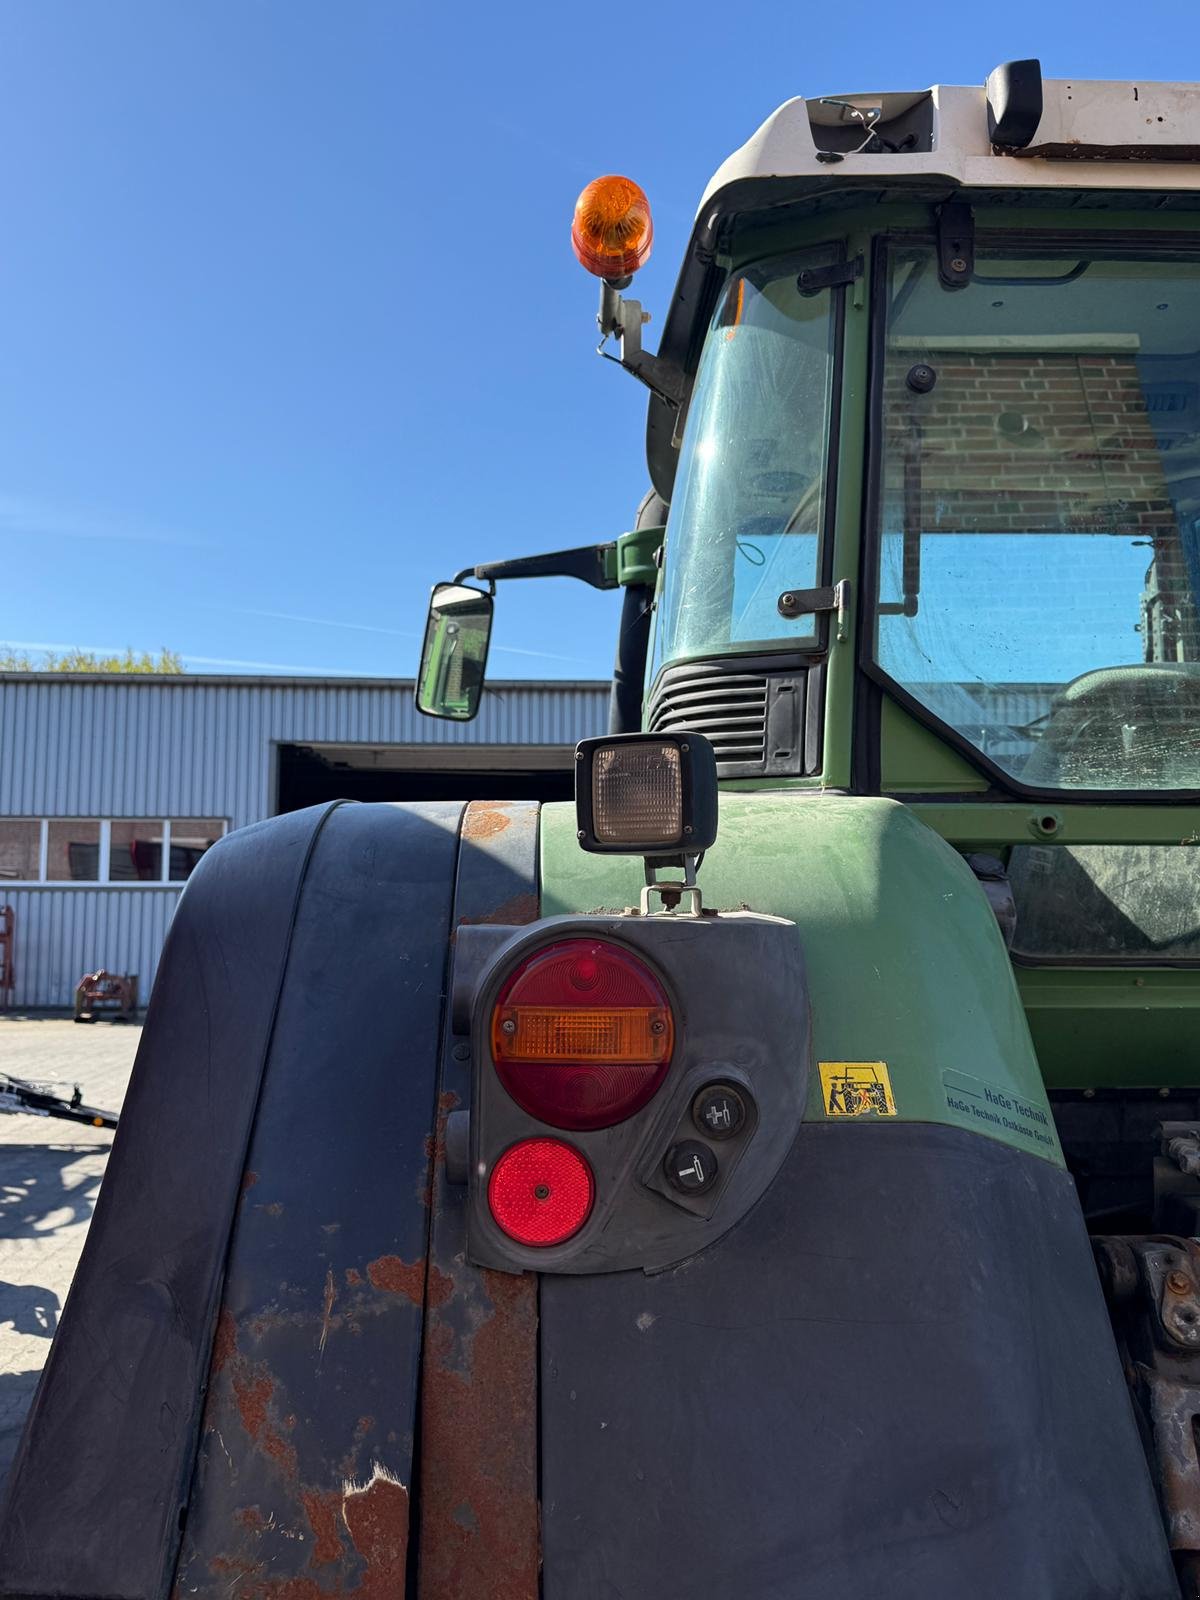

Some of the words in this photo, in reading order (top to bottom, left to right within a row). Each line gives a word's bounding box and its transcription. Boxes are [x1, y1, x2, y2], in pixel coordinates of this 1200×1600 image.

[947, 1097, 970, 1113] HaGe
[971, 1104, 1000, 1125] Technik
[984, 1088, 1012, 1110] HaGe
[1012, 1100, 1048, 1126] Technik
